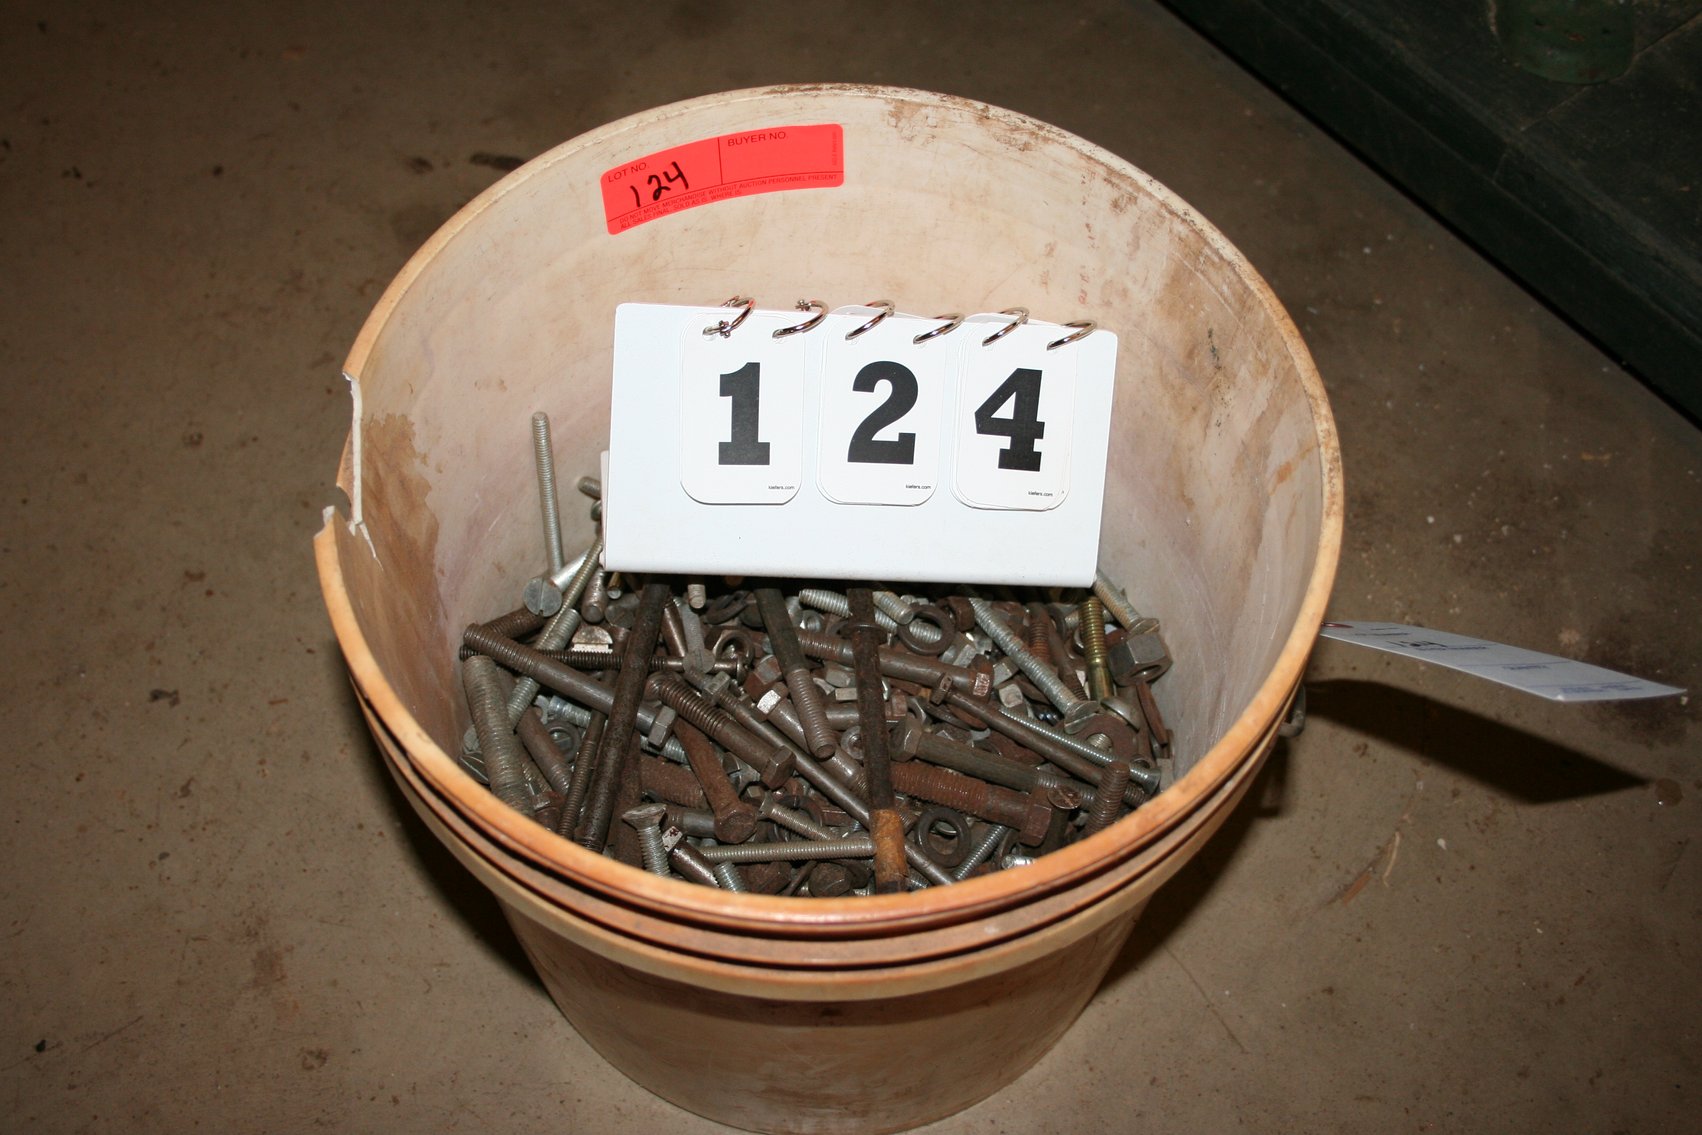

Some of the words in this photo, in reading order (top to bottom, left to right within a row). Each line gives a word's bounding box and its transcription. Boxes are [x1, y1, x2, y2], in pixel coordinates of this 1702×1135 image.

[728, 133, 766, 147] BUYER
[608, 169, 628, 183] LOT
[630, 161, 689, 208] 124
[718, 362, 770, 466] 1
[847, 361, 919, 465] 2
[974, 367, 1045, 472] 4
